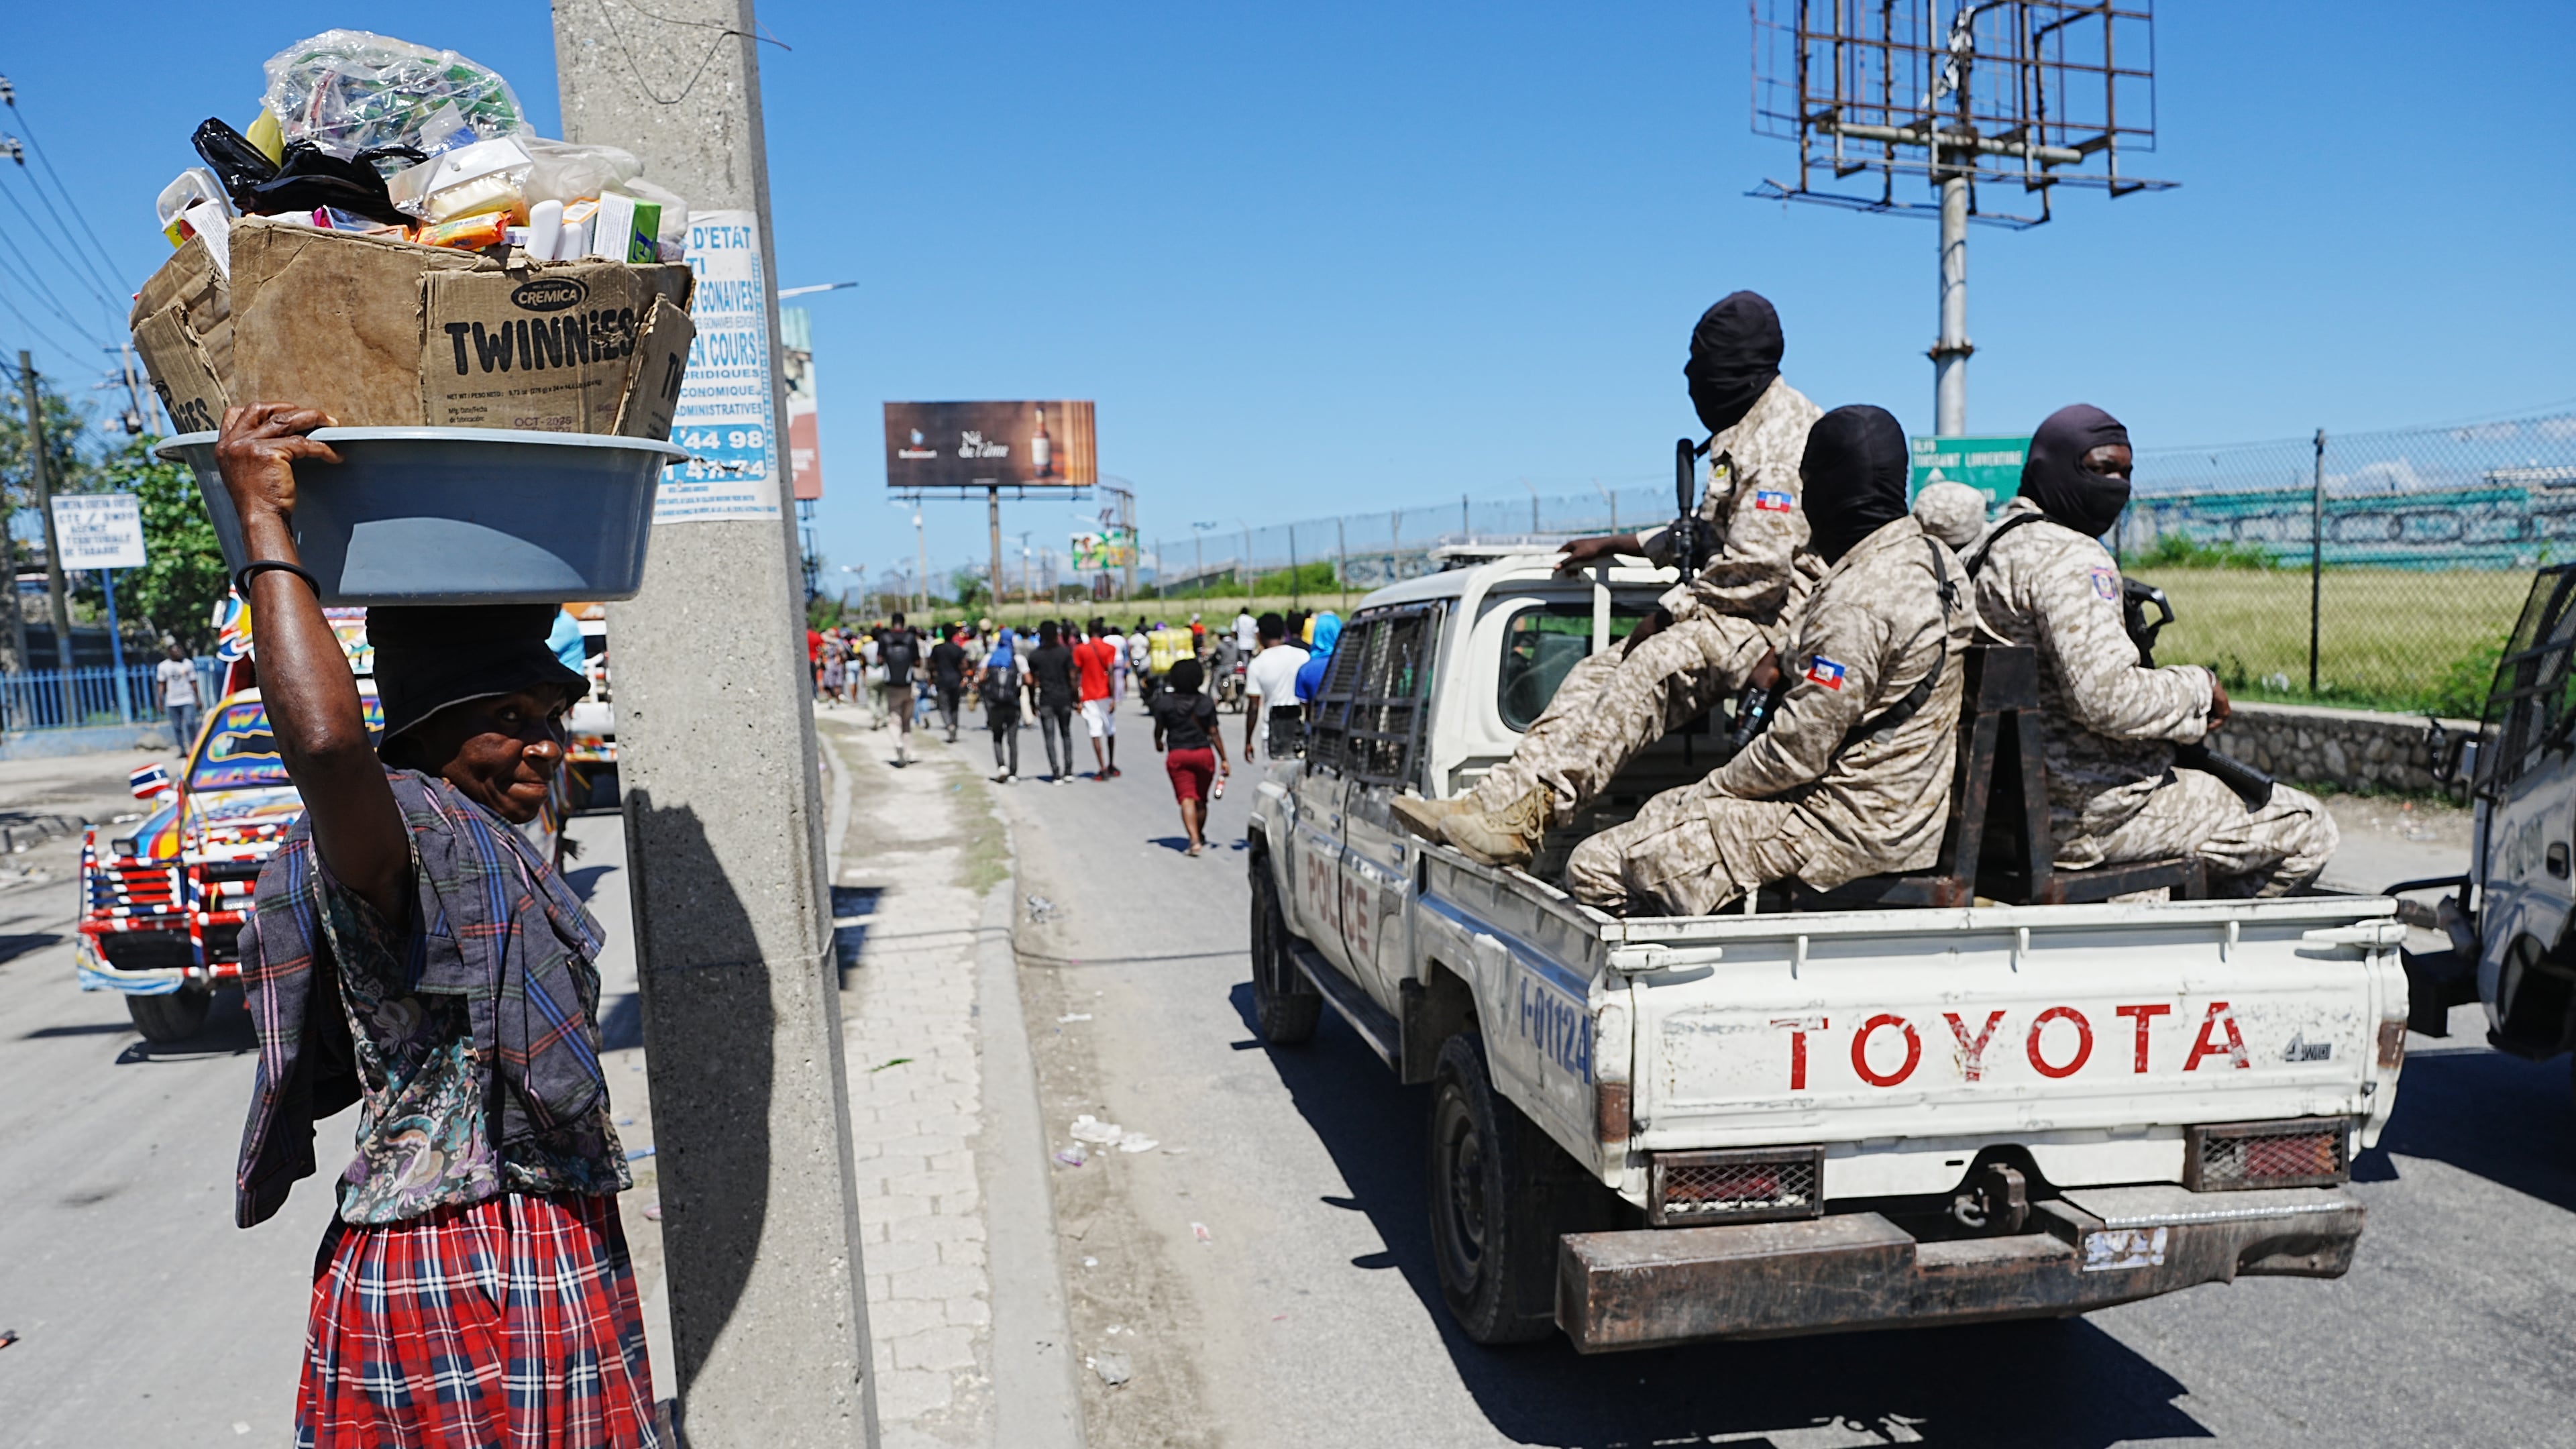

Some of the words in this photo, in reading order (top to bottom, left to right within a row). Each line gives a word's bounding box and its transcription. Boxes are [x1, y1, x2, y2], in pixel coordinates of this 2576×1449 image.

[518, 288, 578, 306] CREMICA
[700, 280, 753, 313] GONAIVES
[710, 332, 757, 366] COURS
[683, 369, 759, 380] URIDIQUES
[680, 385, 762, 398] CONOMIQUE
[728, 430, 764, 449] 98
[1965, 451, 2023, 468] LOUVERTURE
[1307, 852, 1368, 956] POLCE
[1771, 1002, 2250, 1090] TOYOTA
[2285, 1032, 2331, 1061] 4WD
